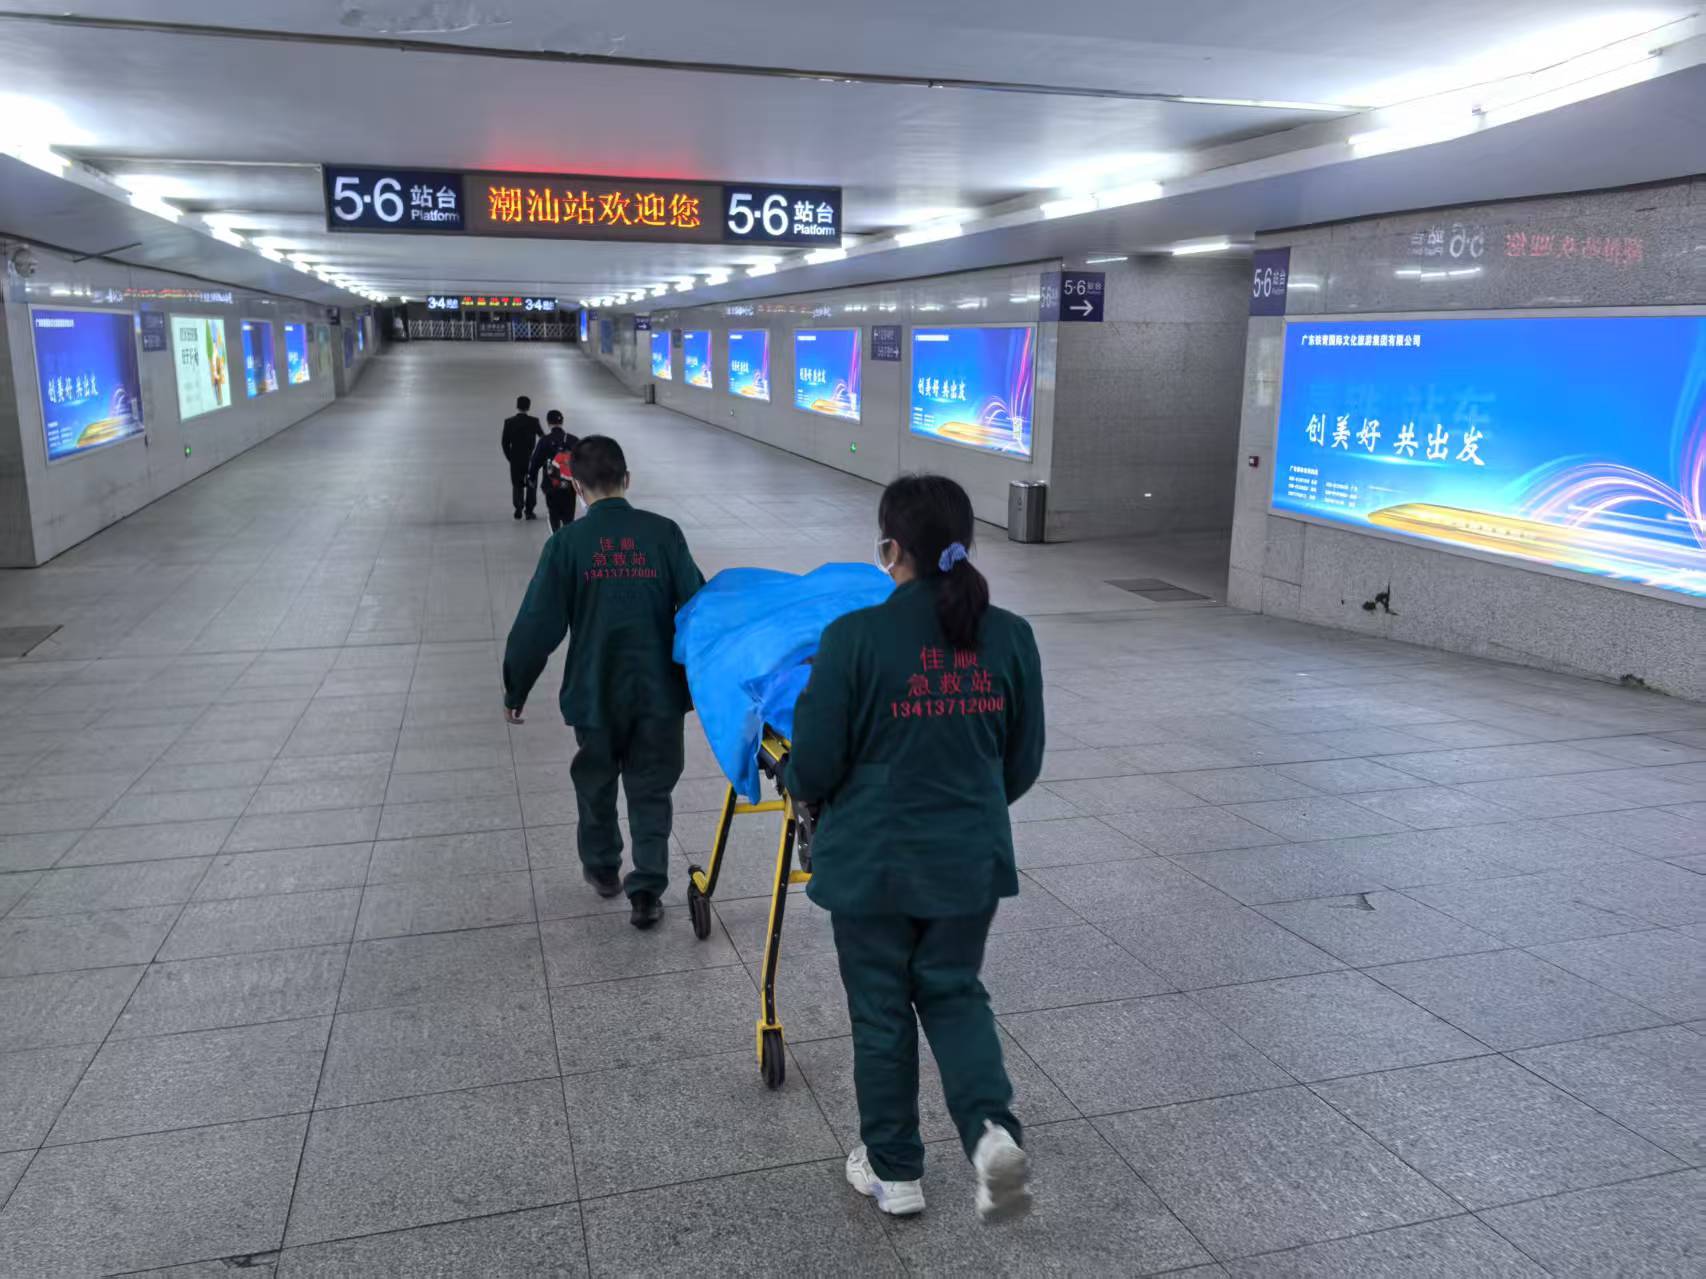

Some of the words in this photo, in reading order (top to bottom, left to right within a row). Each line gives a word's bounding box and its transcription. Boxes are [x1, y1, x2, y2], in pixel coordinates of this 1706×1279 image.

[410, 184, 457, 209] 站台
[488, 186, 700, 228] 潮汕站欢迎您
[411, 209, 459, 222] Platform
[793, 200, 834, 224] 站台
[793, 223, 835, 237] Platform
[1305, 413, 1382, 453] 创美好
[1393, 421, 1486, 466] 共出发
[907, 669, 992, 697] 急救站
[891, 697, 1004, 718] 13413712000
